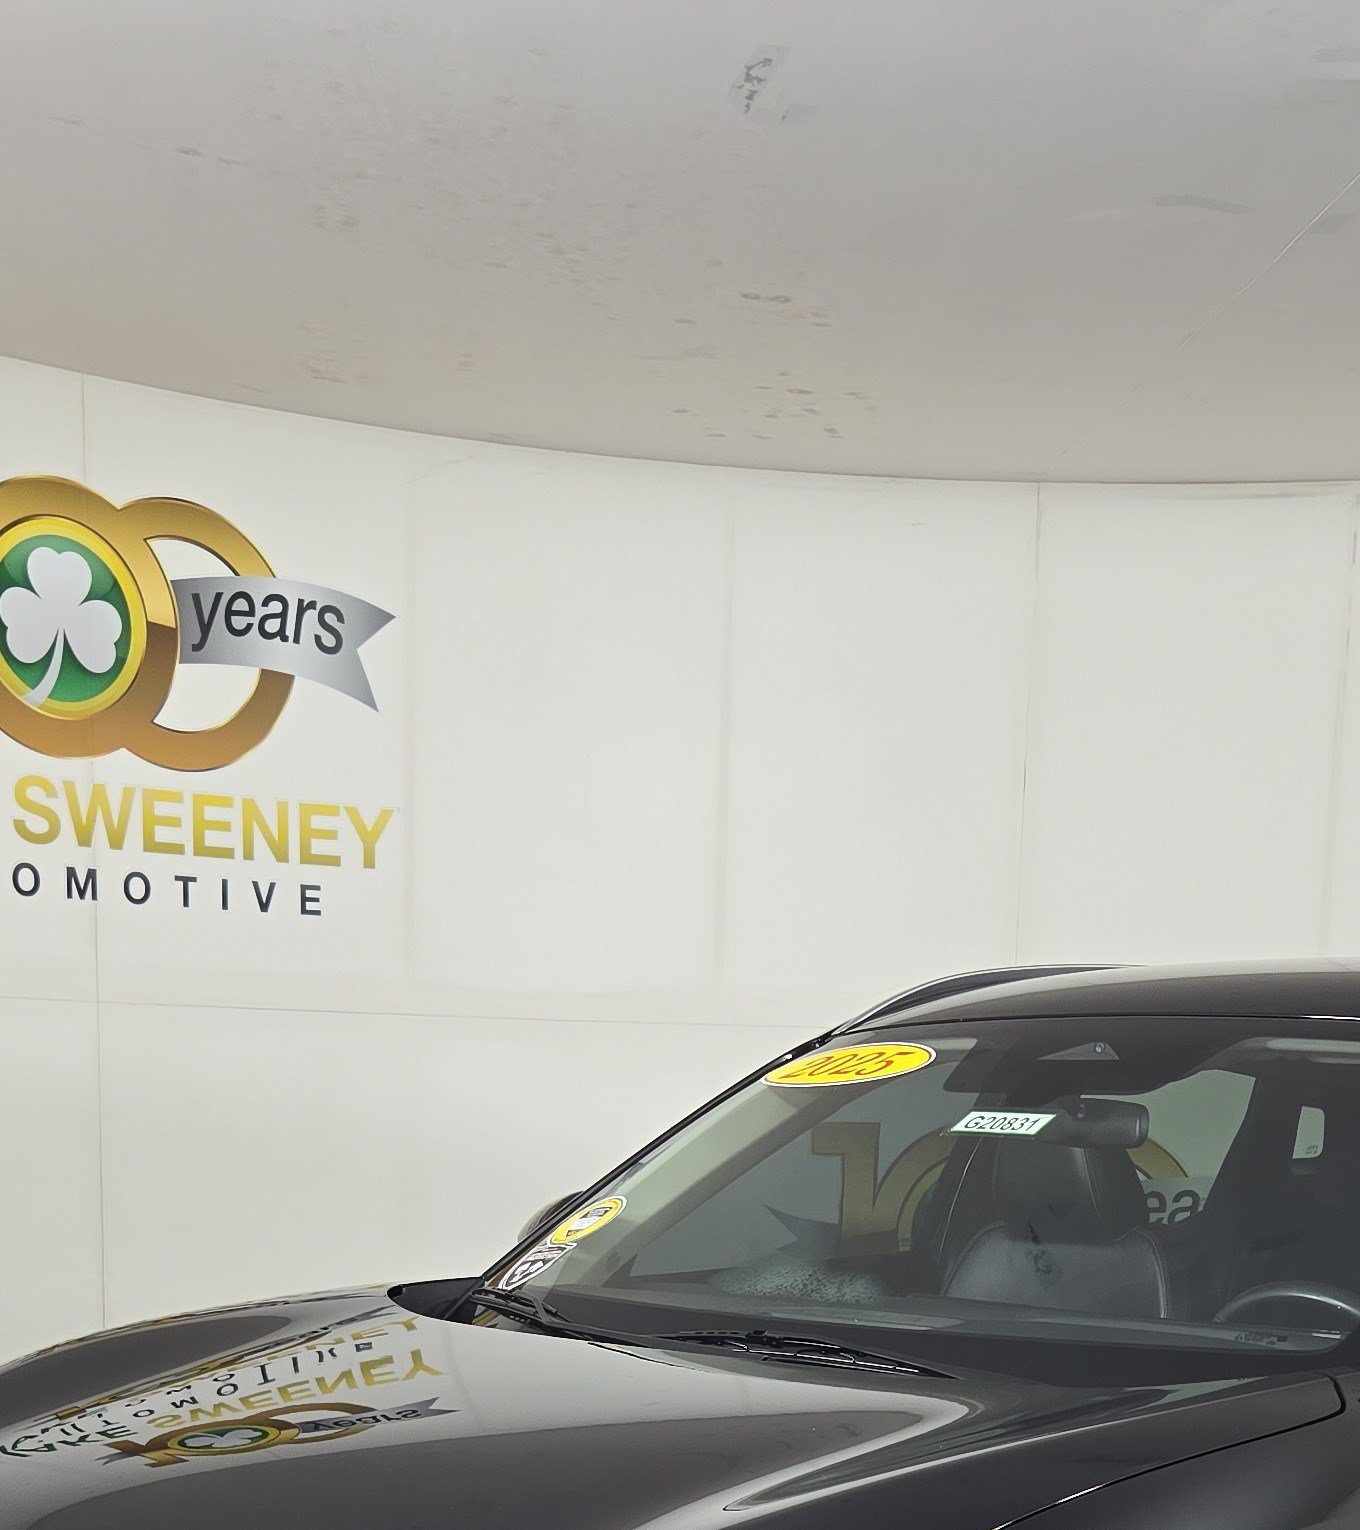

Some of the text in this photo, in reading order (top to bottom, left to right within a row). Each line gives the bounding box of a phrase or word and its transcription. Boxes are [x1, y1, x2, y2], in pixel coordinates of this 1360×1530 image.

[189, 590, 346, 656] years
[11, 774, 395, 870] SWEENEY
[780, 1050, 917, 1079] 2025
[963, 1114, 1042, 1133] G20831
